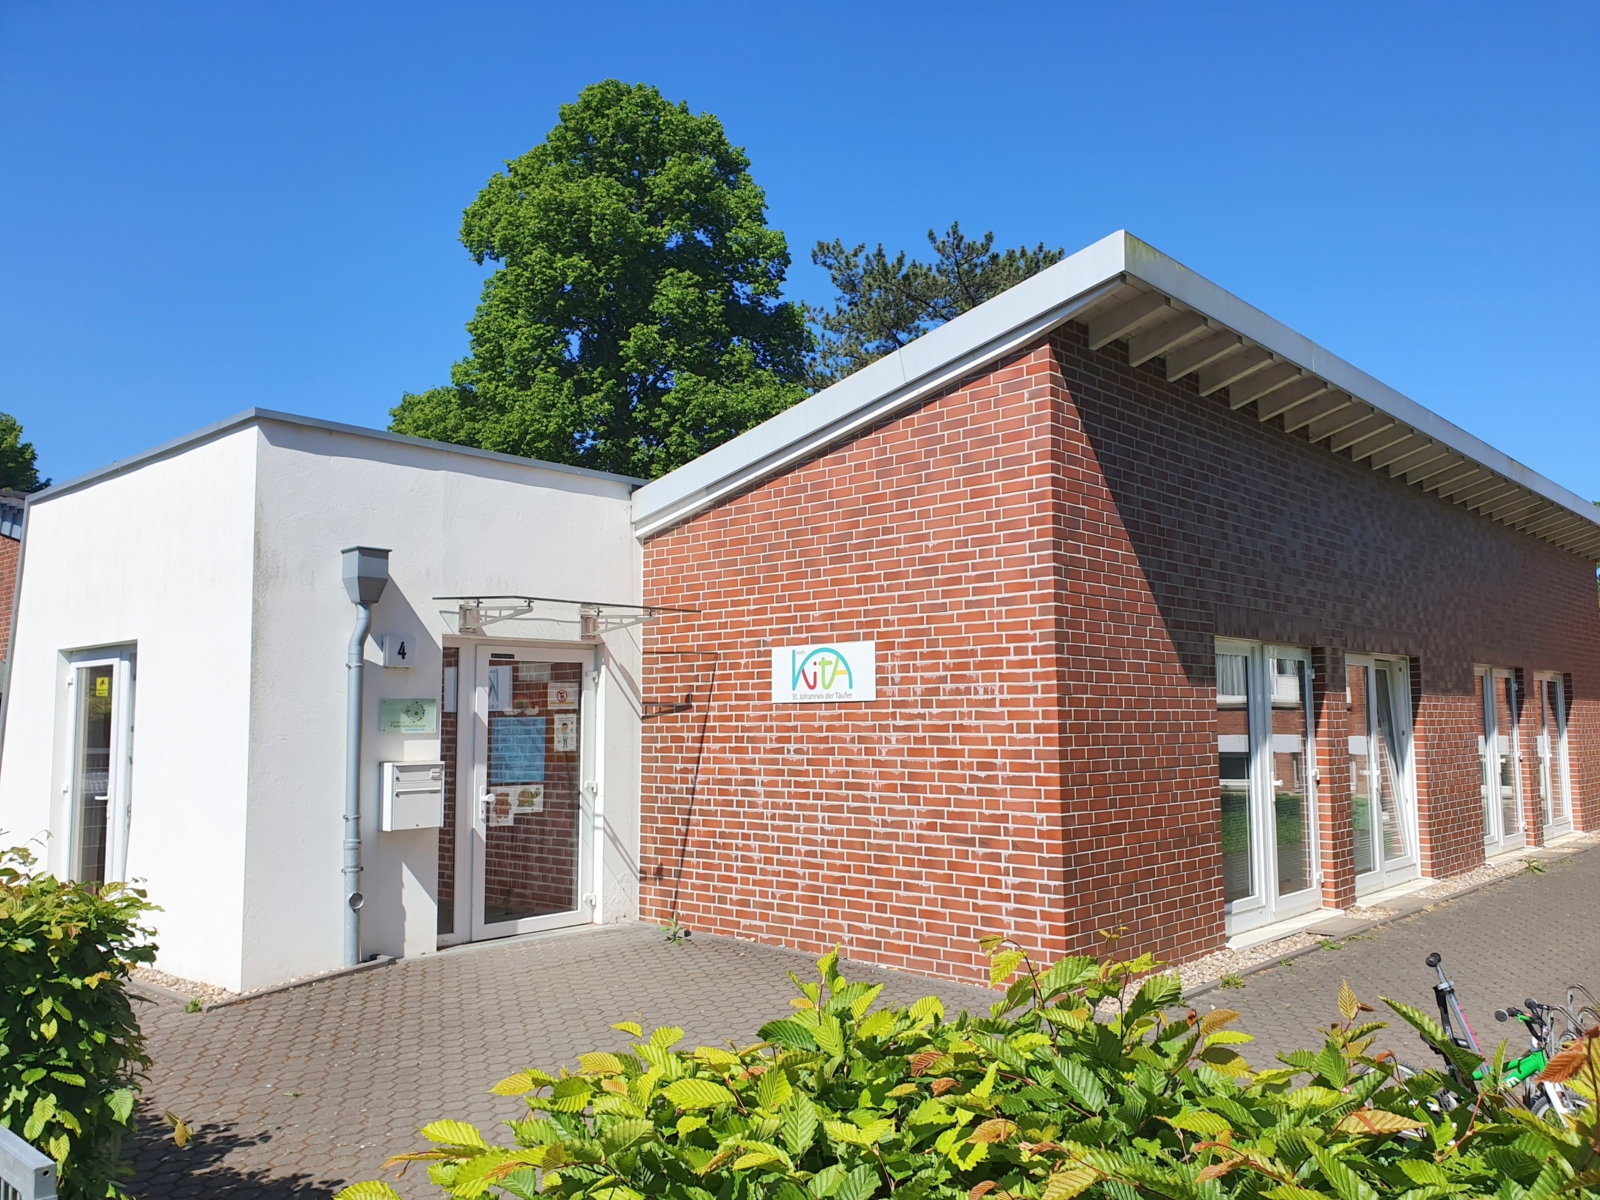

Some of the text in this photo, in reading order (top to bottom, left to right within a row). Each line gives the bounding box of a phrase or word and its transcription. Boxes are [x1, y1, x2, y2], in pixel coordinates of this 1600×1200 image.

[397, 641, 407, 659] 4
[799, 692, 824, 700] Johannes
[835, 691, 853, 699] Täufer
